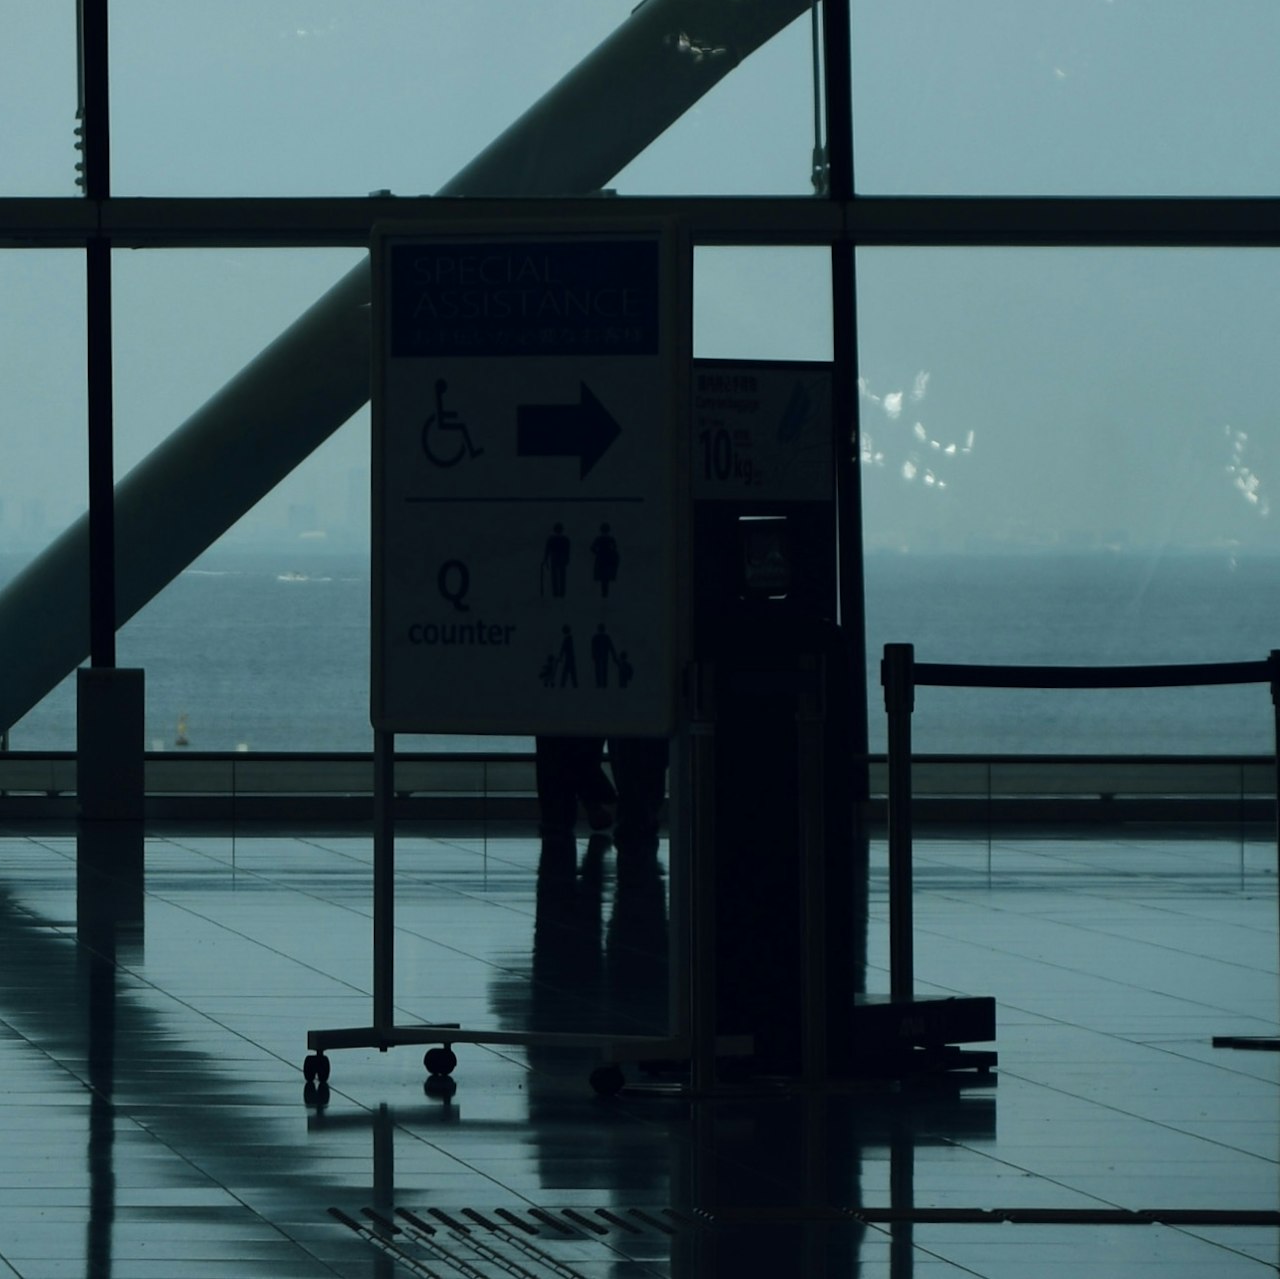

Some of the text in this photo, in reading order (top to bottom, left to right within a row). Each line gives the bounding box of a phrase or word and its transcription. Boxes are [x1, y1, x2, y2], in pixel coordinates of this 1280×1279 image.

[413, 255, 562, 286] SPECIAL
[411, 287, 643, 319] ASSISTANCE
[699, 428, 732, 481] 10
[734, 452, 753, 486] kg
[437, 558, 471, 613] Q
[407, 619, 518, 646] counter
